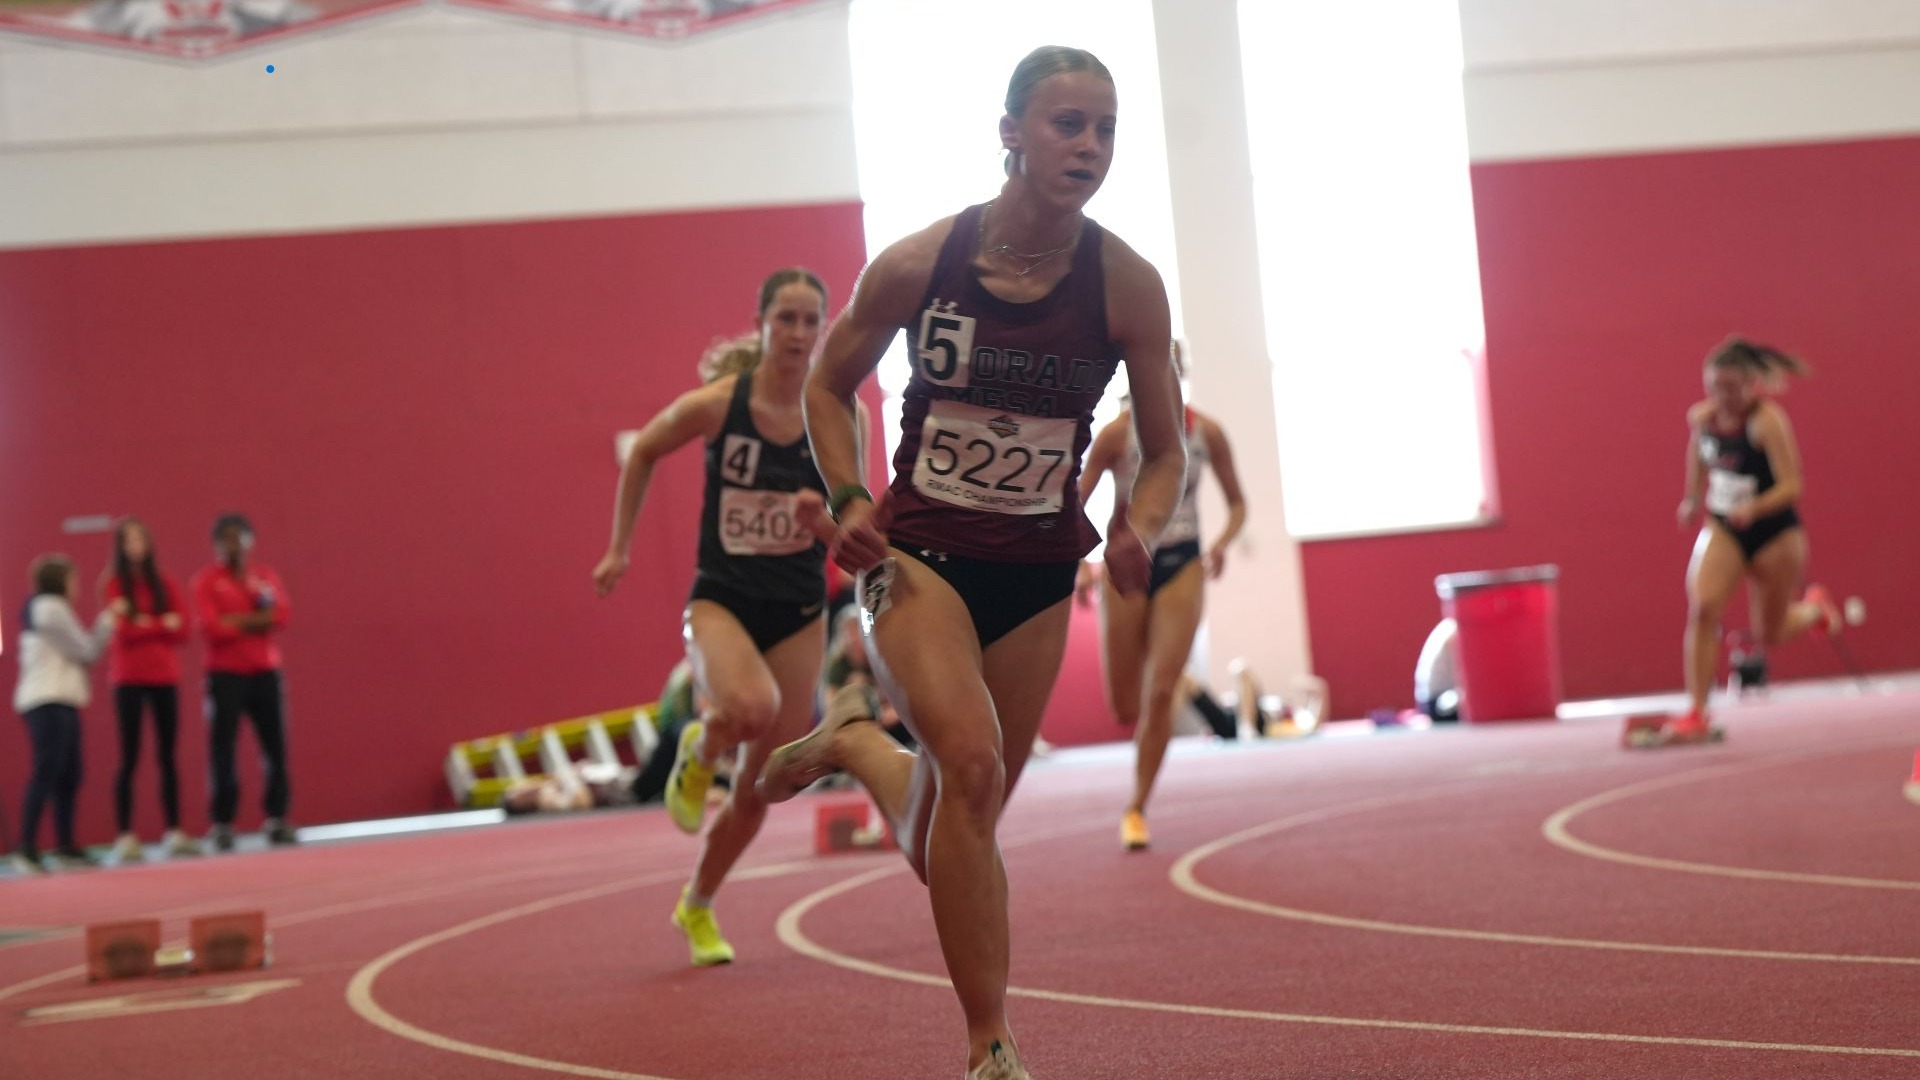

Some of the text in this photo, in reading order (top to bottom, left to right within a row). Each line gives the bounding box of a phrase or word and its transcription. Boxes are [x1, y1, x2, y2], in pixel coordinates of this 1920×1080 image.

[923, 315, 961, 381] 5
[726, 443, 751, 479] 4
[926, 429, 1066, 492] 5227
[926, 479, 1048, 507] RMAC CHAMPIONSHIP
